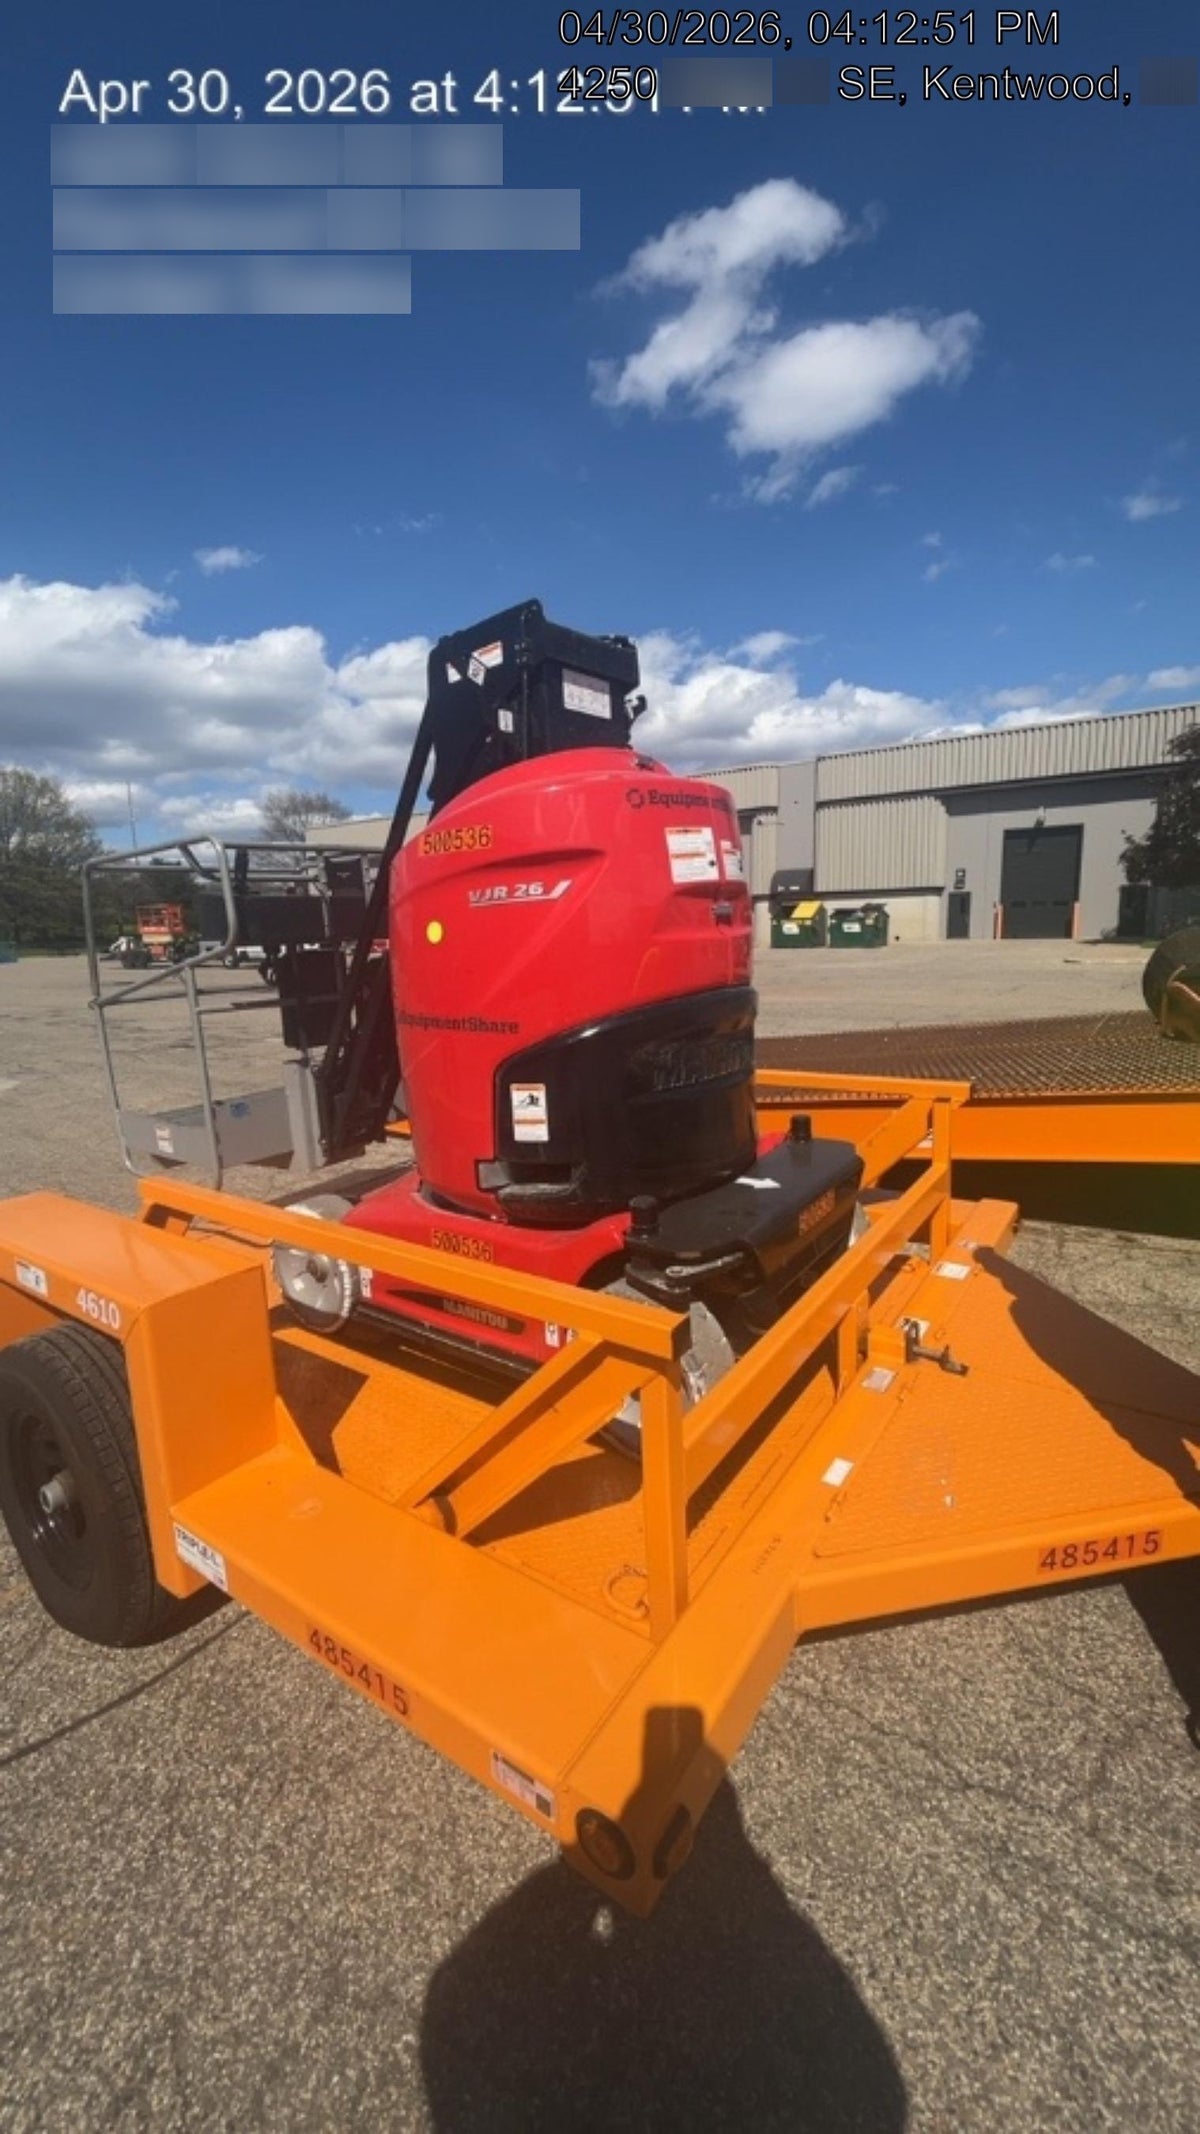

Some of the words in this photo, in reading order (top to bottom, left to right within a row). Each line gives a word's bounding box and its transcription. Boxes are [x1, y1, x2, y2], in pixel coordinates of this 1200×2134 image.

[423, 826, 491, 854] 500536
[513, 882, 544, 897] 26
[76, 1287, 120, 1329] 4610
[1040, 1530, 1161, 1571] 485415
[310, 1628, 408, 1716] 485415
